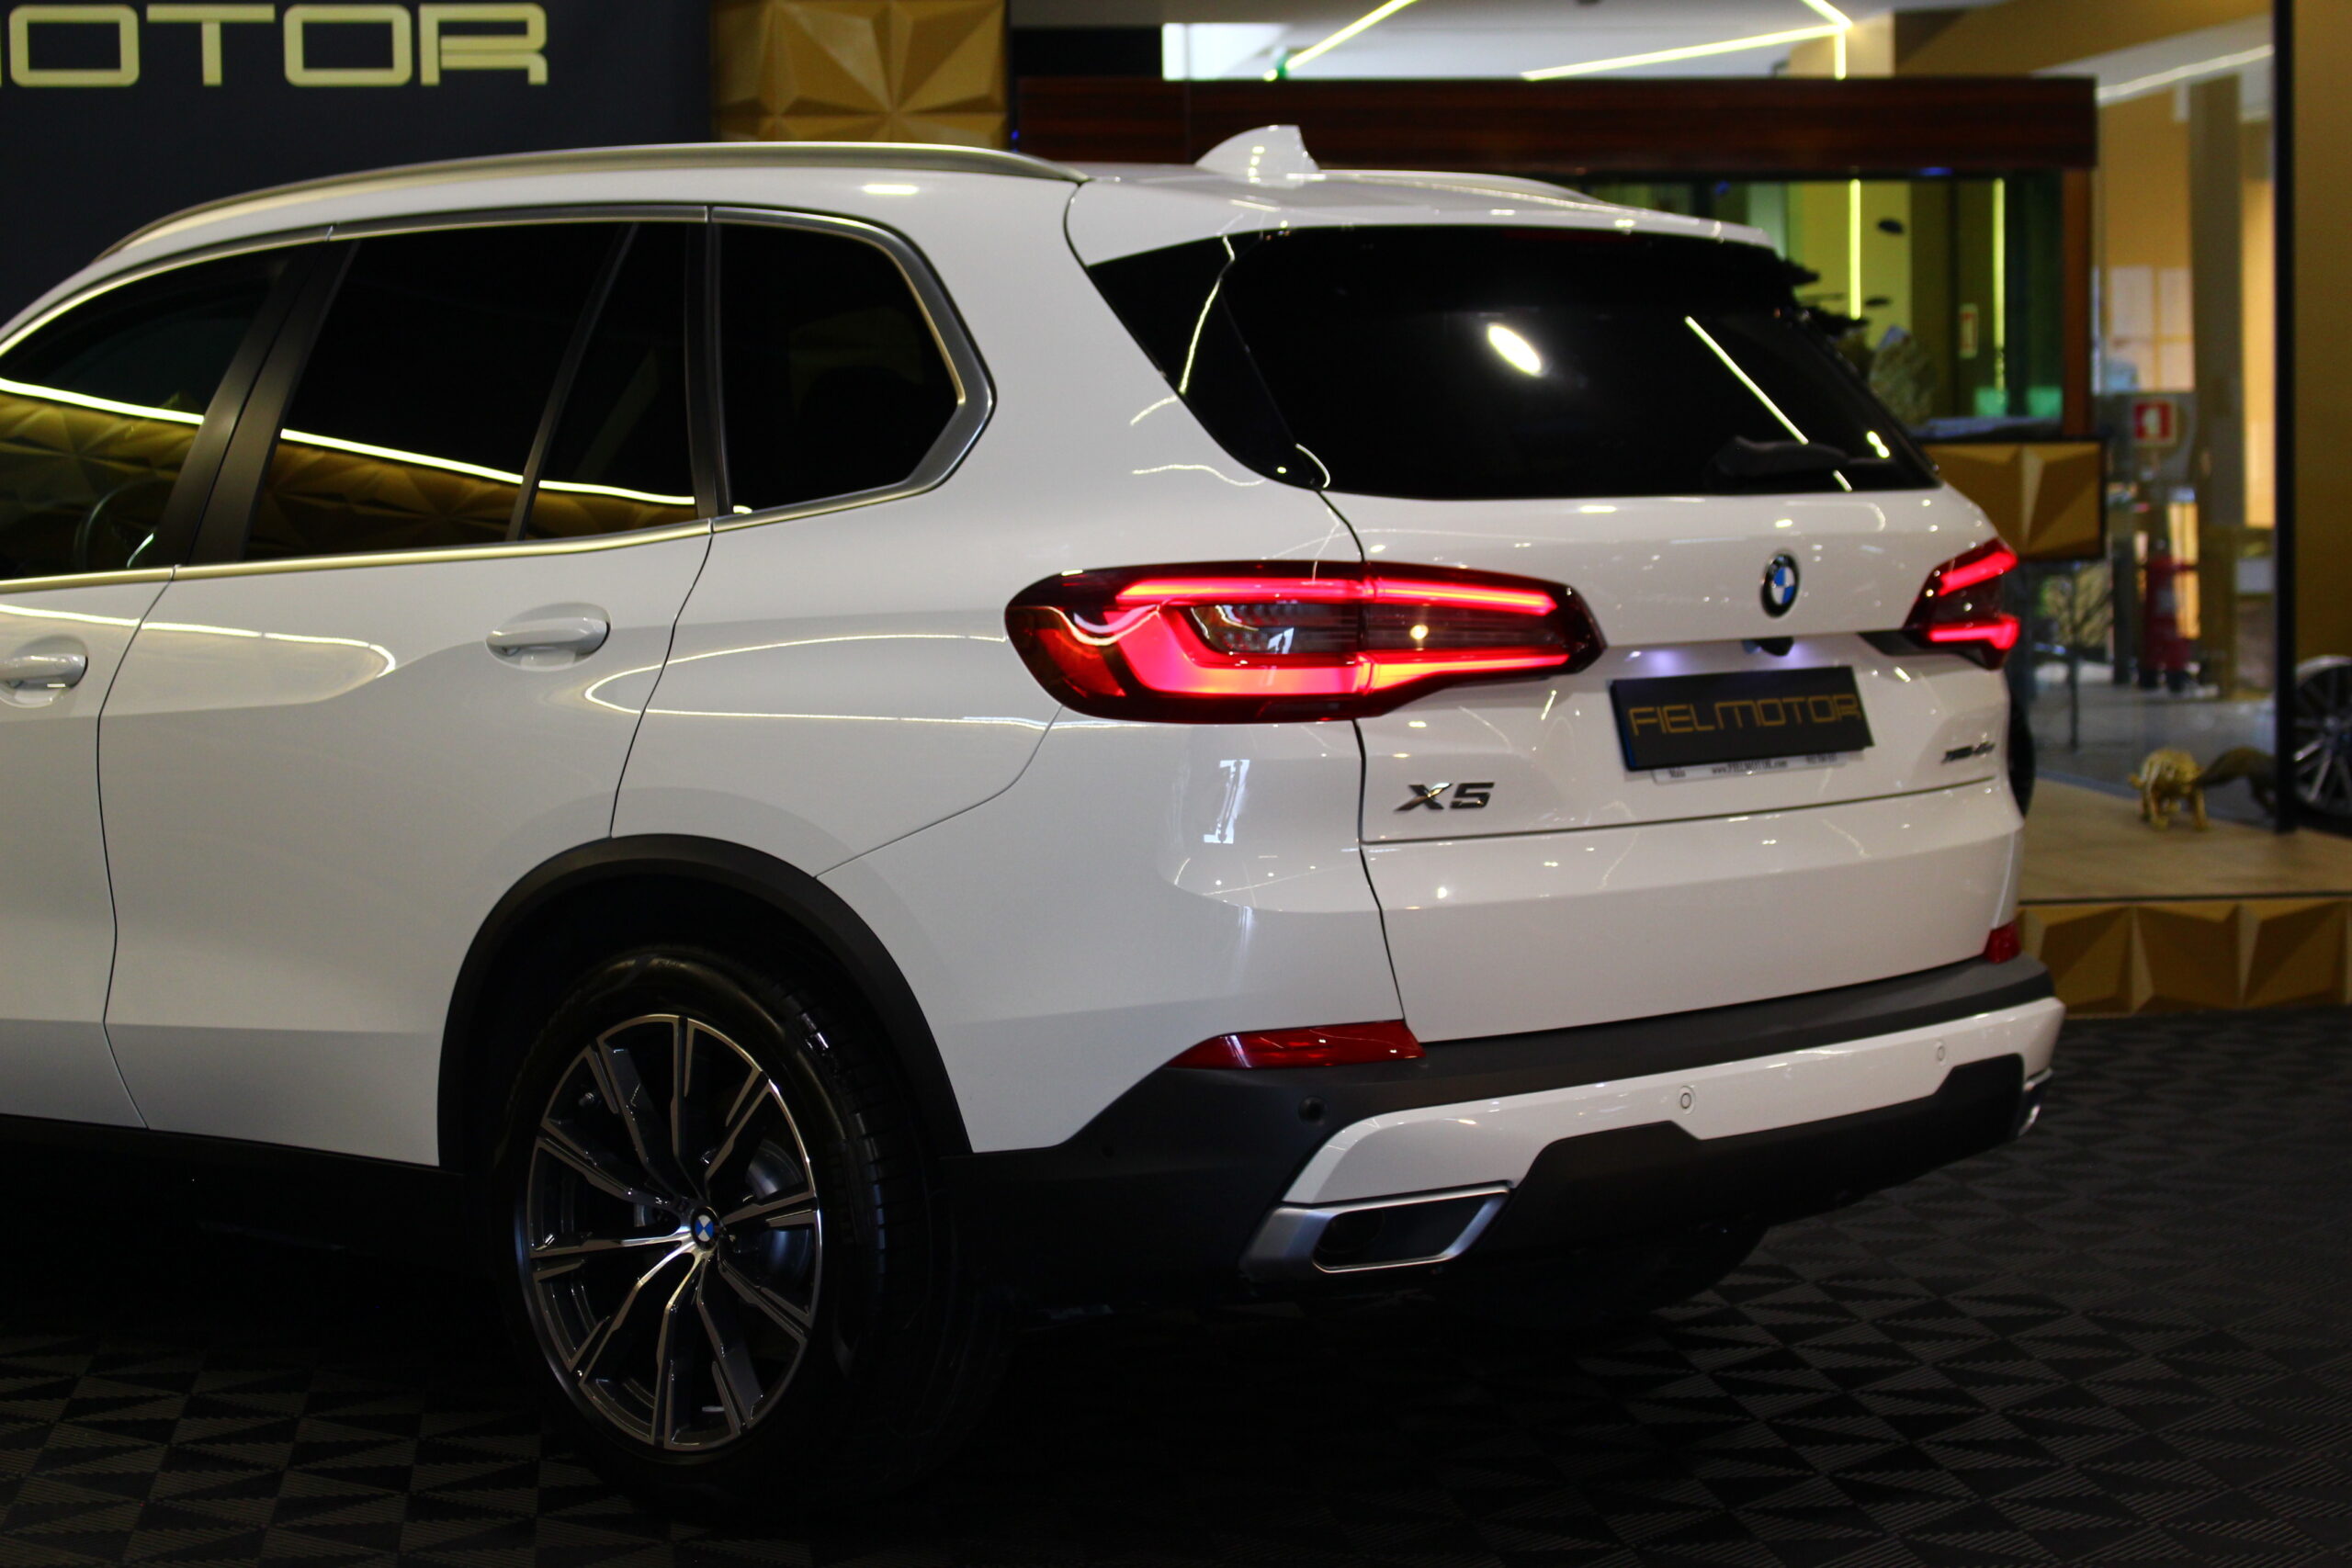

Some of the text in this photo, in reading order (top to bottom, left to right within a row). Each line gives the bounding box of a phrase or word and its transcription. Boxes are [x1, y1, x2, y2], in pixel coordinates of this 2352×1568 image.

[0, 4, 548, 87] OTOR
[1628, 694, 1862, 736] FIELMOTOR
[1394, 782, 1495, 812] X5
